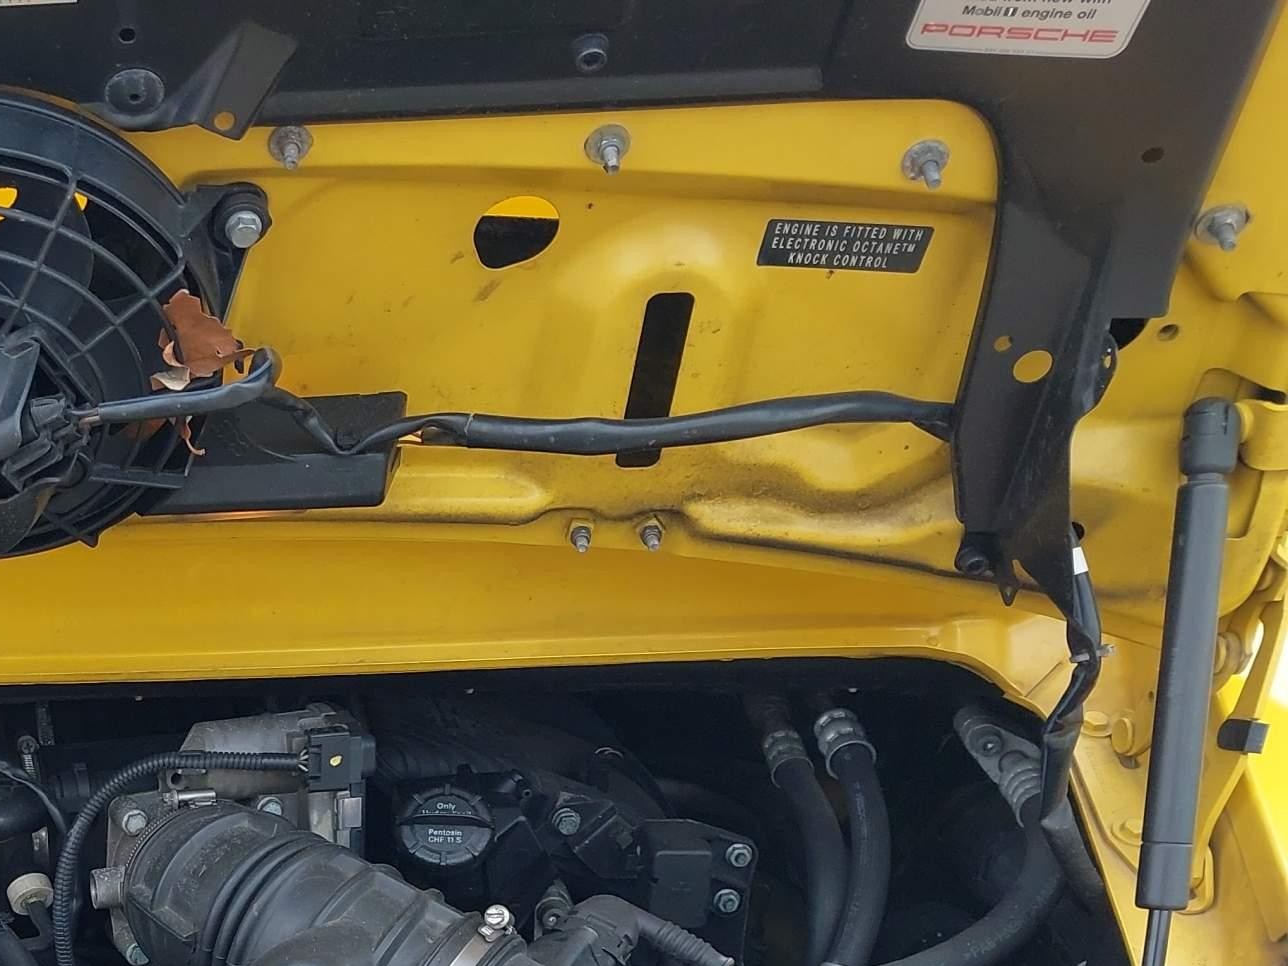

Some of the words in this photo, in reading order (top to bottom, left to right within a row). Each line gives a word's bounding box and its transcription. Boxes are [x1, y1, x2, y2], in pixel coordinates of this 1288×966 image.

[962, 5, 1003, 17] Mobil
[1021, 9, 1073, 21] engine
[1077, 8, 1097, 19] oil
[920, 23, 1119, 43] PORSCHE
[775, 222, 821, 236] ENGINE
[825, 225, 838, 237] IS
[843, 226, 887, 240] FITTED
[893, 228, 924, 241] WITH
[771, 237, 847, 252] ELECTRONIC
[788, 252, 828, 265] KNOCK
[833, 255, 887, 268] CONTROL
[437, 802, 456, 811] Only
[428, 828, 463, 837] Pentosin
[428, 836, 445, 844] CHF
